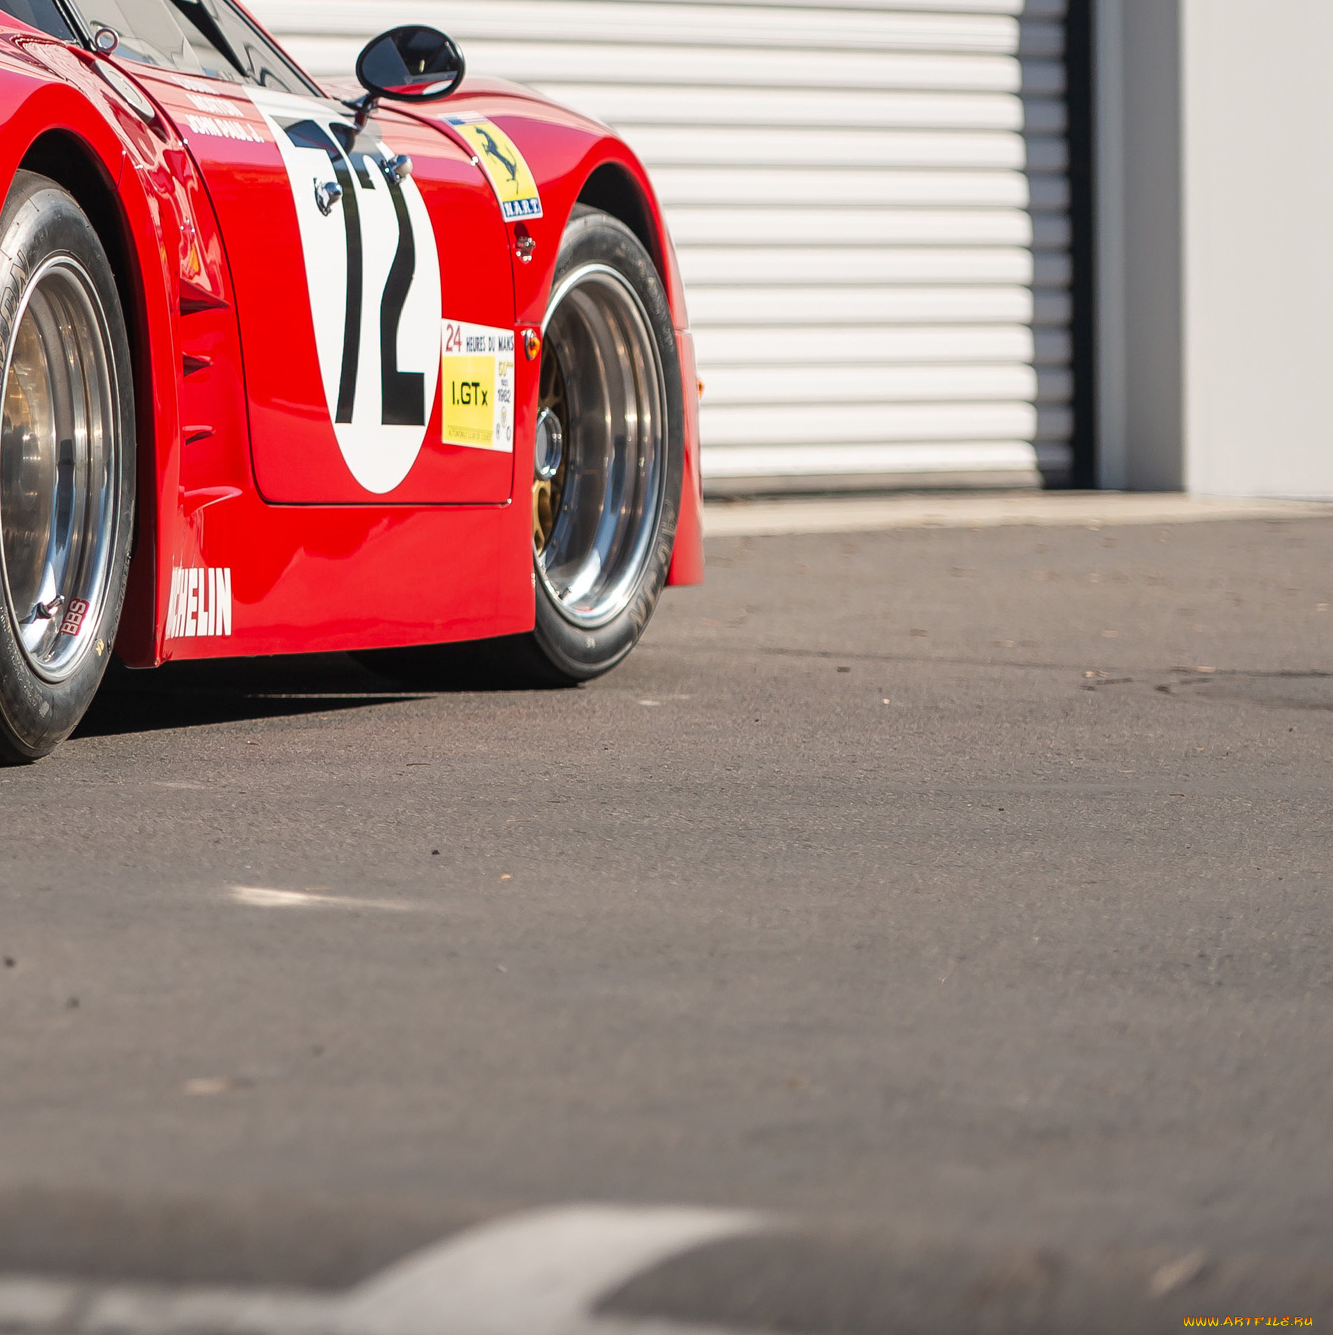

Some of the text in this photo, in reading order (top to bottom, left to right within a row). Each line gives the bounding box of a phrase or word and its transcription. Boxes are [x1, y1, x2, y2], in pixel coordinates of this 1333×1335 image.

[269, 114, 426, 427] 72
[445, 323, 515, 353] 24 HEURES DU MANS
[61, 599, 87, 636] BBS
